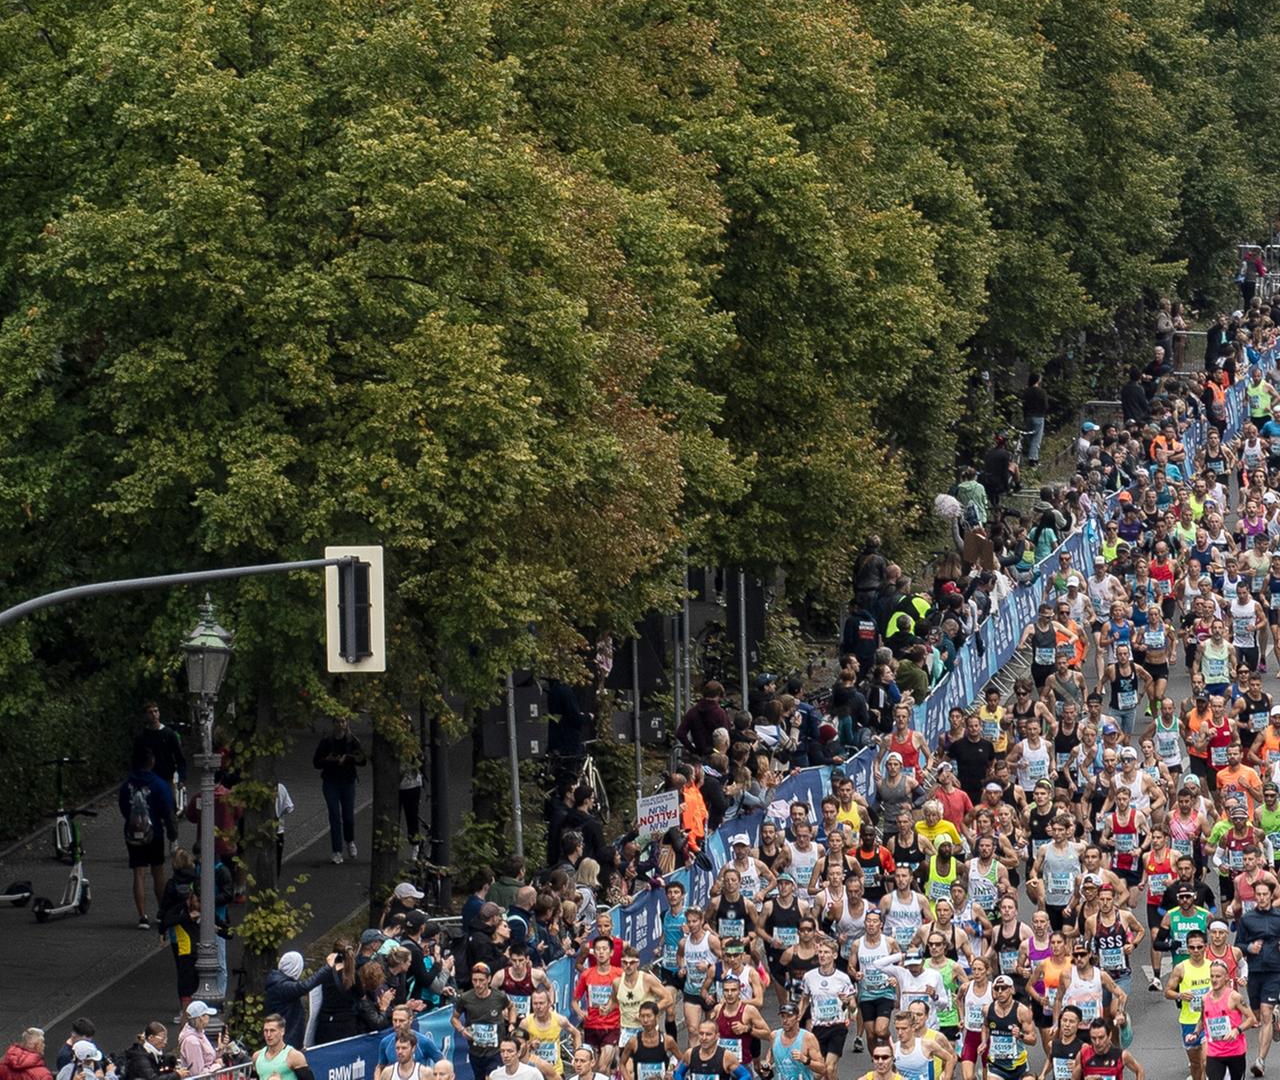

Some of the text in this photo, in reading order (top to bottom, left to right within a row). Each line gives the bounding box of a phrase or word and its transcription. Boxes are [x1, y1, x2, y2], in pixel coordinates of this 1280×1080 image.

[1177, 922, 1200, 931] BRASIL
[1099, 934, 1123, 949] SSS
[328, 1065, 352, 1080] BMW
